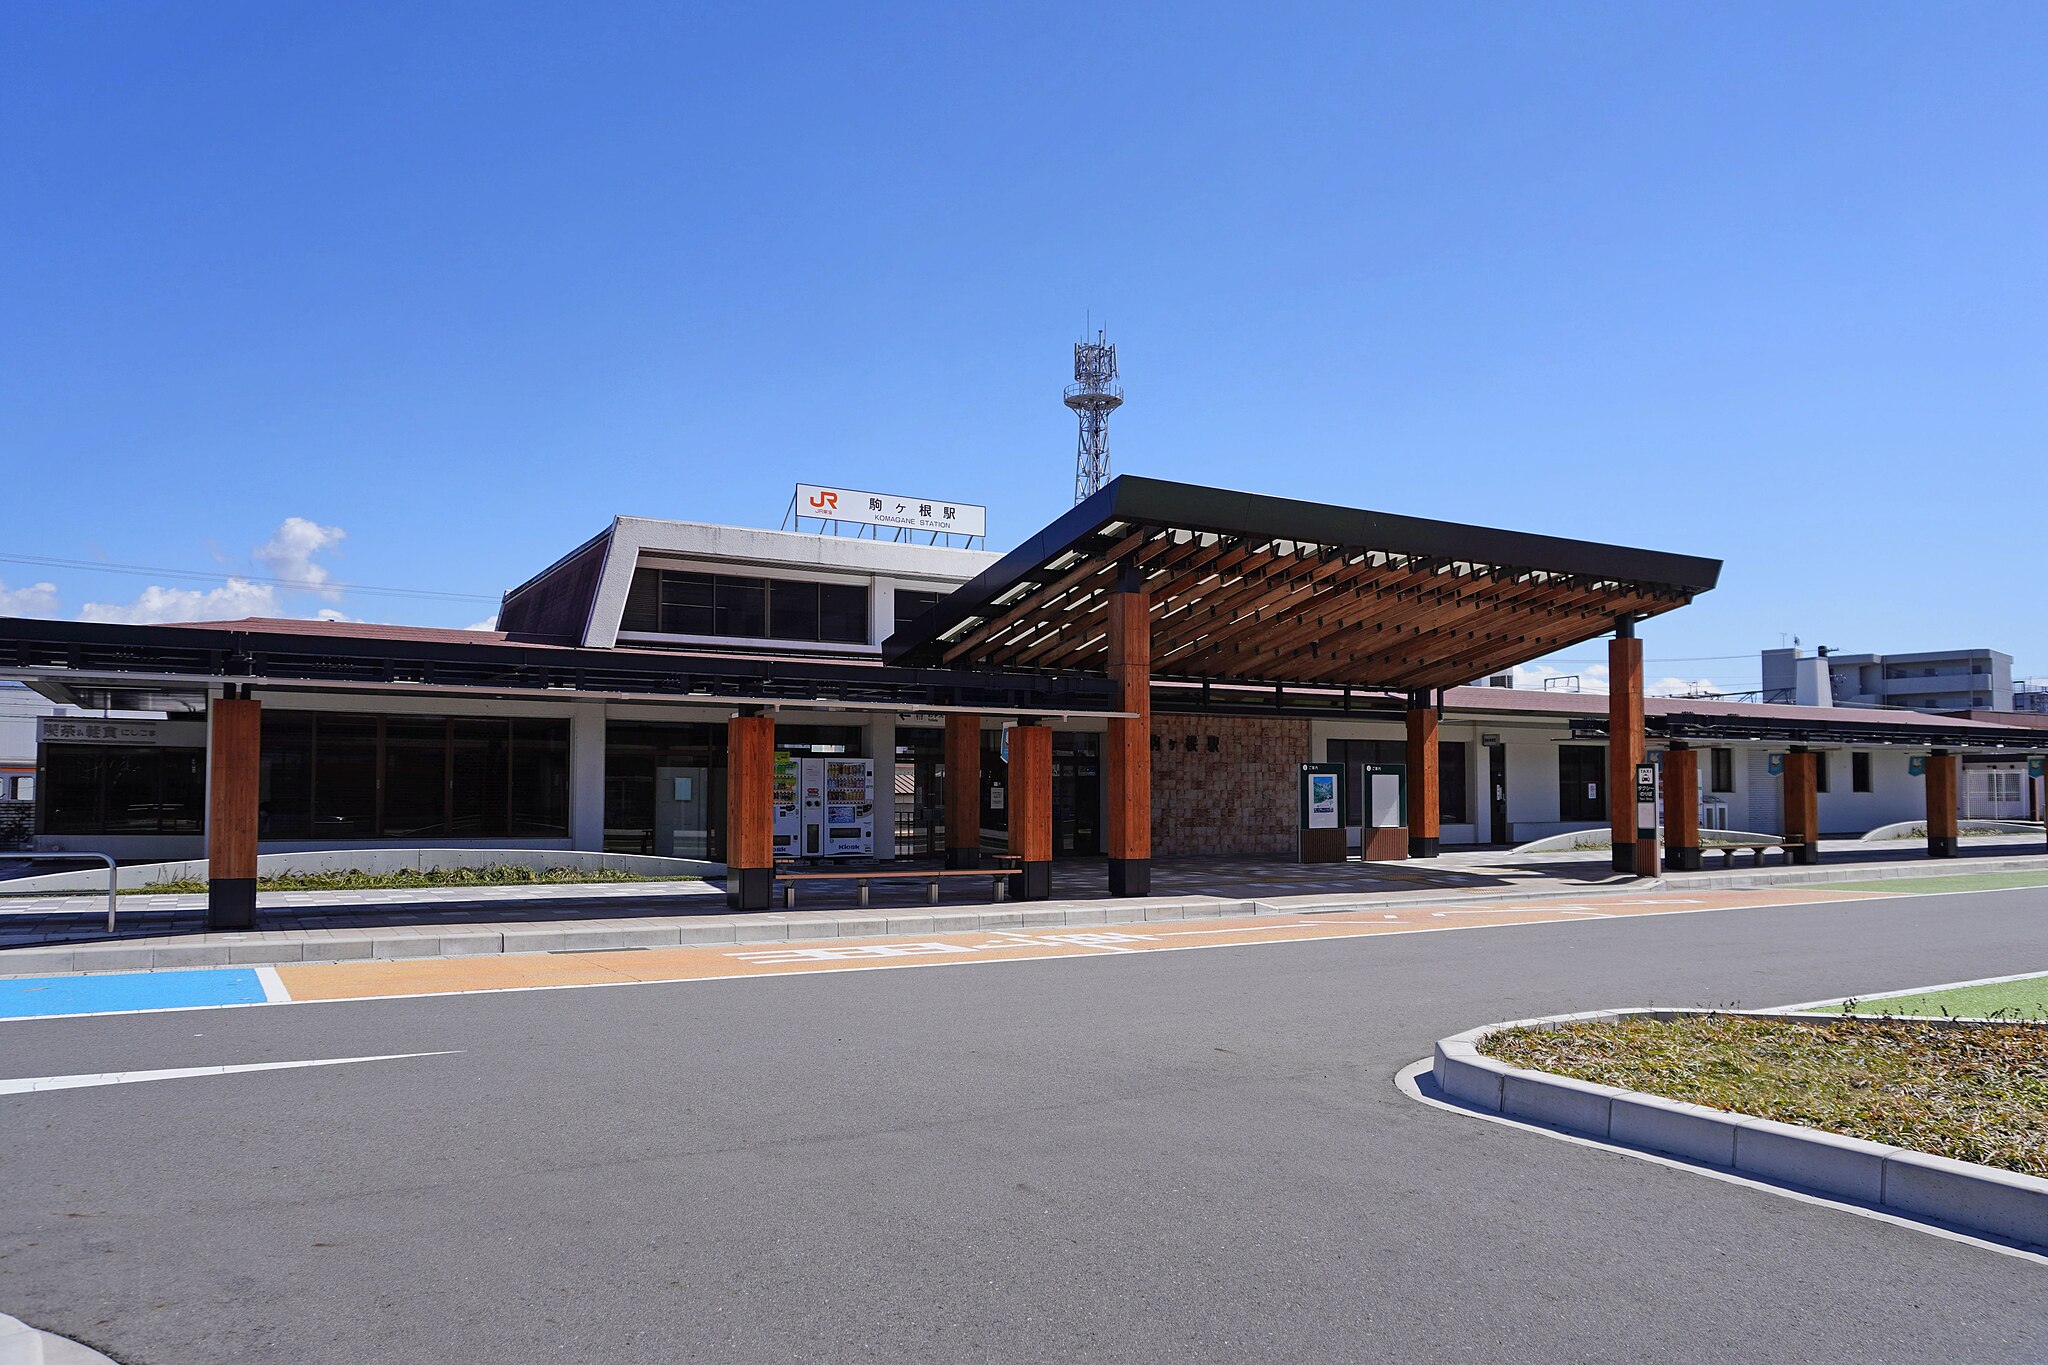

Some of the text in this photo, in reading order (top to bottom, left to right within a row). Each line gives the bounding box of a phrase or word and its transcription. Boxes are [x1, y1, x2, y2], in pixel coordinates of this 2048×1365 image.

[810, 492, 838, 509] JR
[874, 514, 951, 529] KOMAGANE STATION
